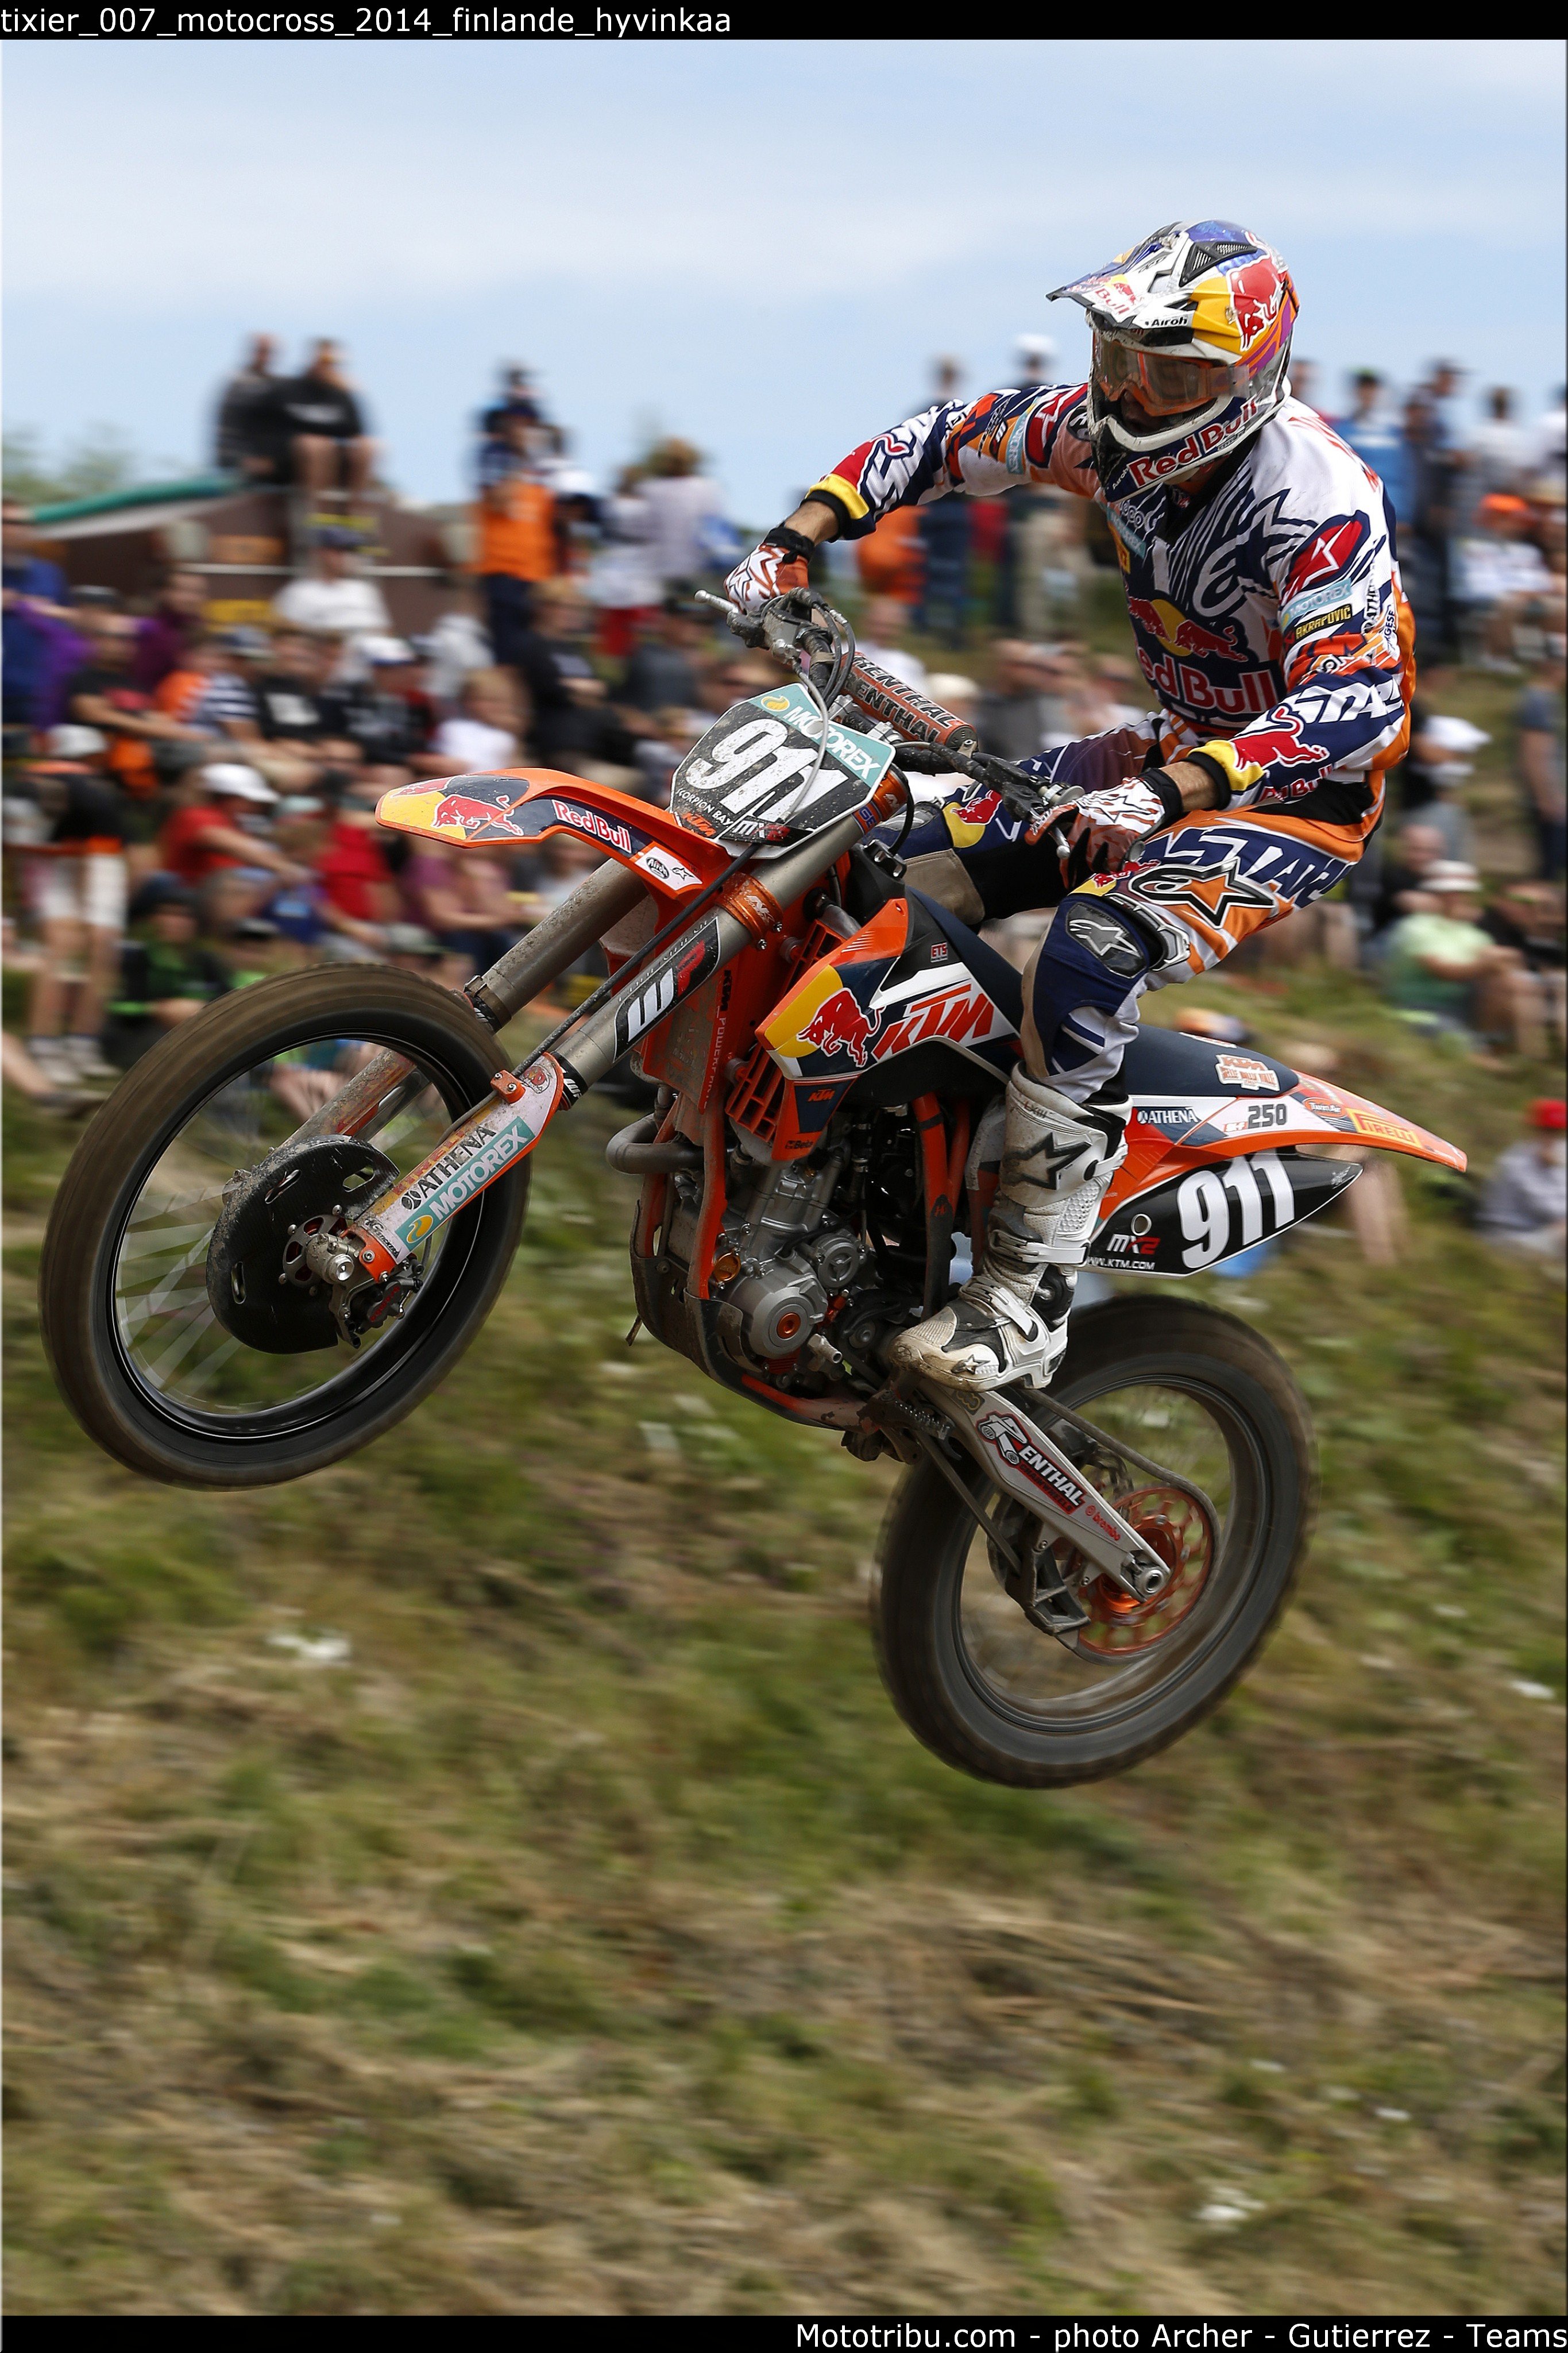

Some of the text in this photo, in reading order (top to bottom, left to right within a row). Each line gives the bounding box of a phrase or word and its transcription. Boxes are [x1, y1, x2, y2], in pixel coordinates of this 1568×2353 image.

[1151, 317, 1188, 327] Airoh
[1127, 435, 1202, 488] Red
[1199, 398, 1258, 454] Bull
[1289, 582, 1350, 615] MOTOREX
[1179, 663, 1279, 715] Bull
[685, 718, 849, 823] 911
[551, 799, 632, 854] Red Bull
[675, 788, 734, 830] SCORPION BAY
[681, 812, 717, 837] KTM
[931, 943, 948, 959] ETS
[871, 983, 995, 1060] KTM
[808, 1089, 835, 1102] KTM
[1148, 1108, 1199, 1124] ATHENA
[1248, 1104, 1288, 1129] 250
[1355, 1112, 1416, 1142] PIRELLI
[417, 1125, 497, 1199] ATHENA
[429, 1125, 529, 1220] MOTOREX
[1177, 1148, 1295, 1268] 911
